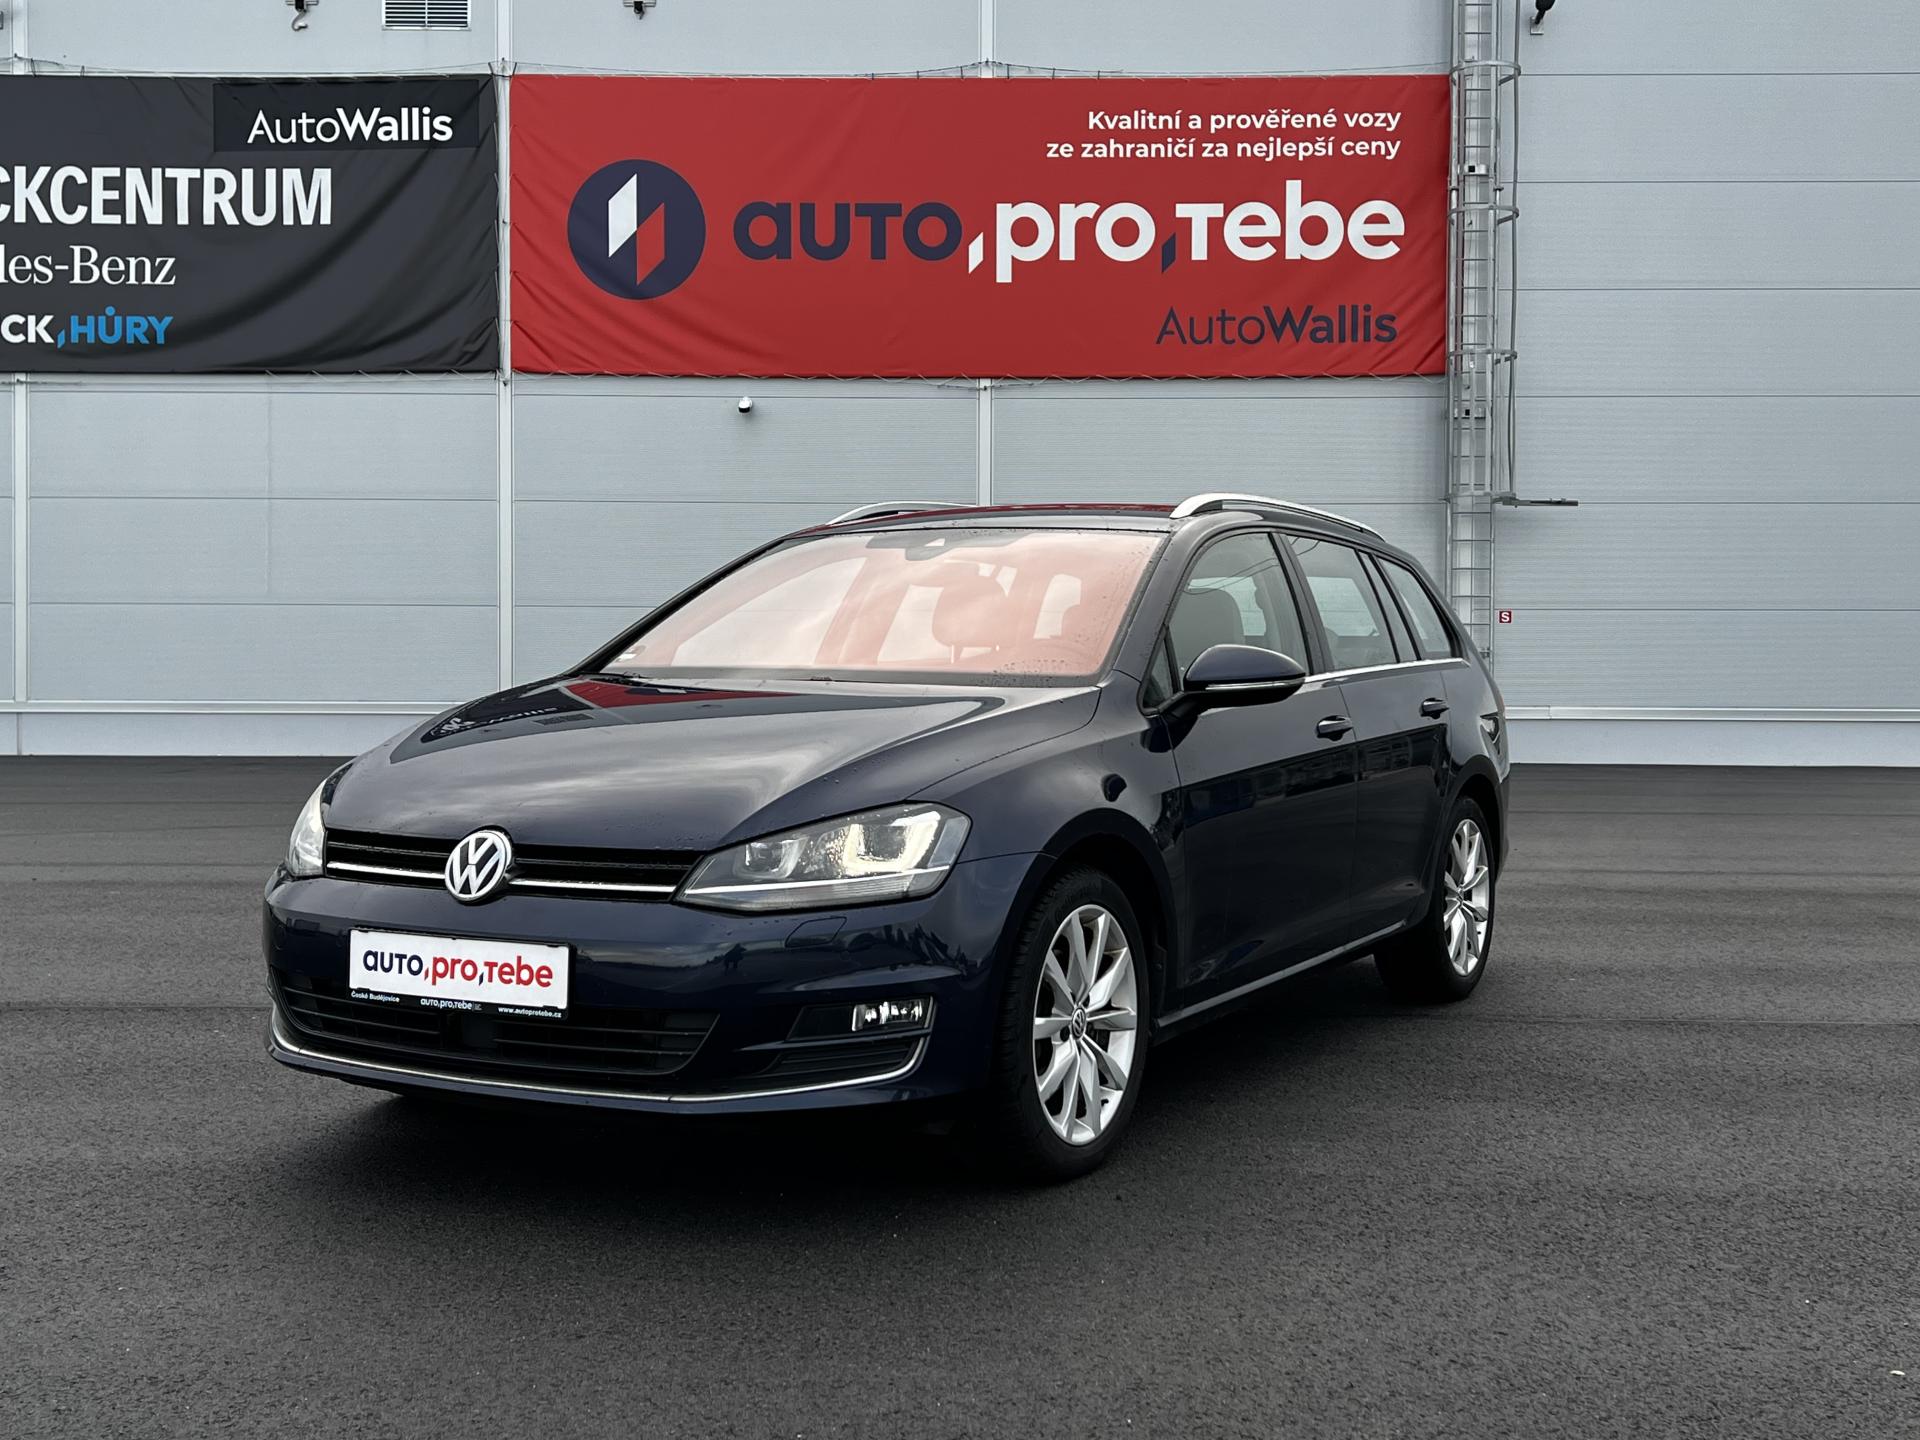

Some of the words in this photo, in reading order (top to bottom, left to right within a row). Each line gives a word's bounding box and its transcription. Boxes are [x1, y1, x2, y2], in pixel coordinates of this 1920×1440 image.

[247, 106, 453, 144] AutoWallis
[1088, 109, 1183, 130] Kvalitní
[1187, 114, 1202, 130] a
[1210, 107, 1338, 134] prověřené
[1343, 111, 1402, 132] vozy
[1046, 142, 1075, 158] ze
[1080, 137, 1196, 158] zahraničí
[1201, 142, 1229, 158] za
[1236, 136, 1336, 162] nejlepší
[1340, 140, 1401, 161] ceny
[0, 165, 332, 226] KCENTRUM
[0, 244, 176, 285] es-Benz
[1156, 303, 1398, 345] AutoWallis
[1500, 611, 1510, 622] S
